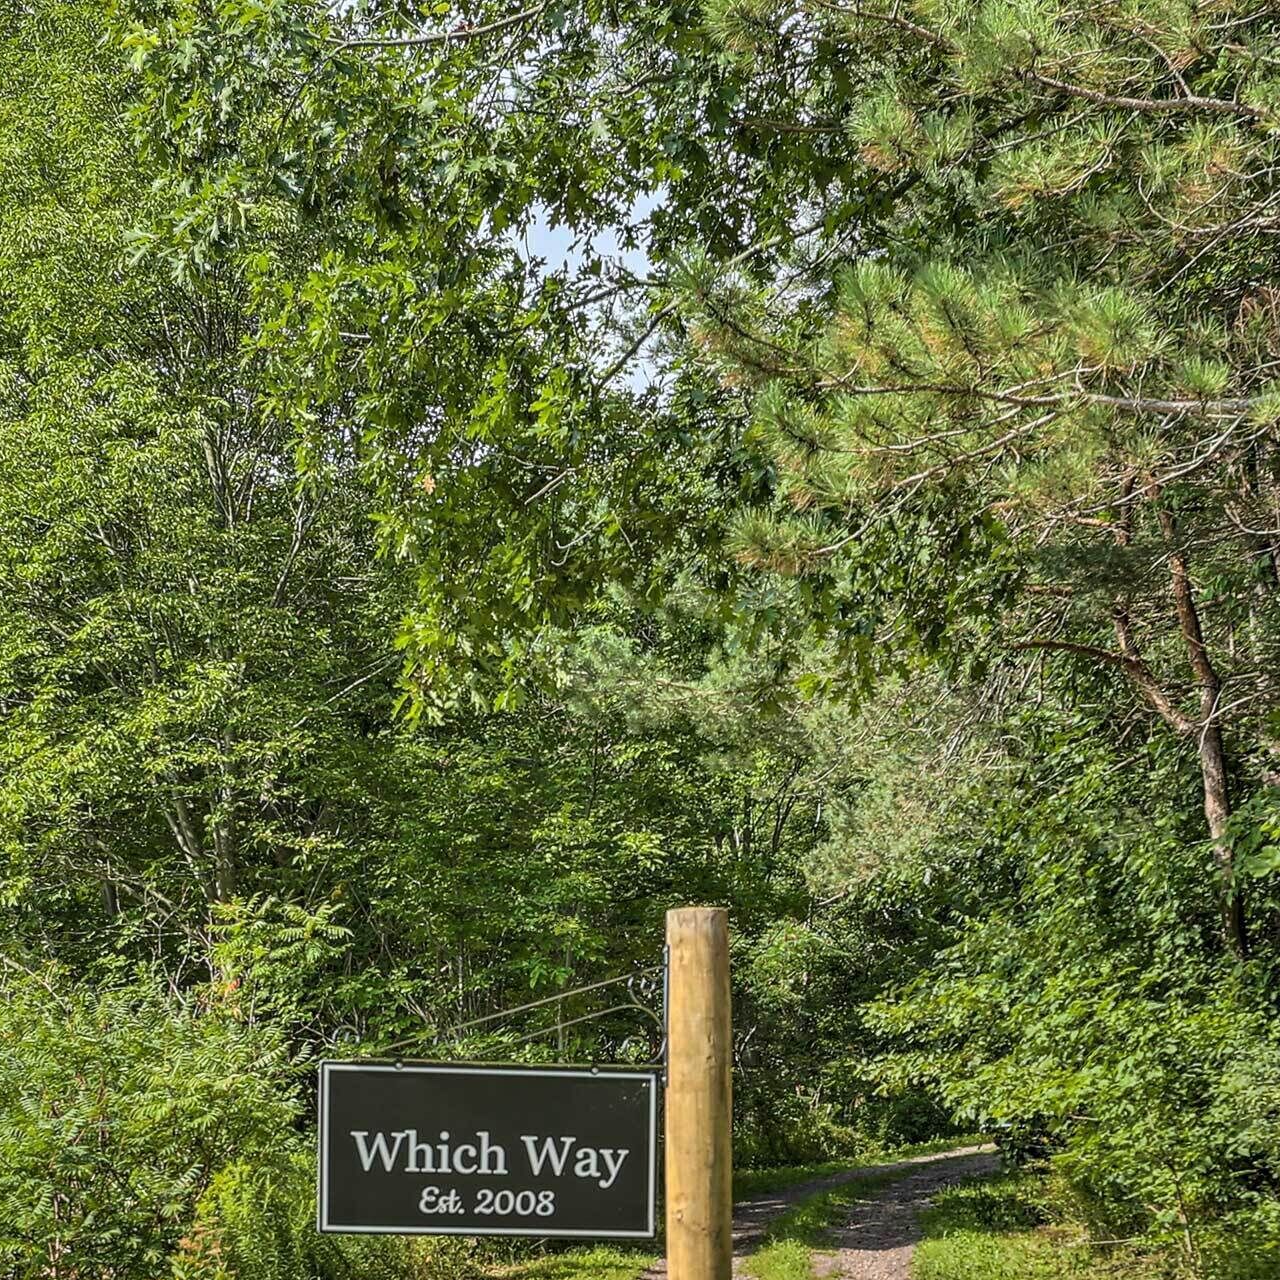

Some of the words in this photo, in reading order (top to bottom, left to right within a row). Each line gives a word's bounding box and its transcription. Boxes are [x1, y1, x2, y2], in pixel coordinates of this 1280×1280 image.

[350, 1129, 508, 1175] Which
[520, 1136, 629, 1188] Way
[418, 1186, 465, 1215] Est.
[473, 1189, 556, 1216] 2008
